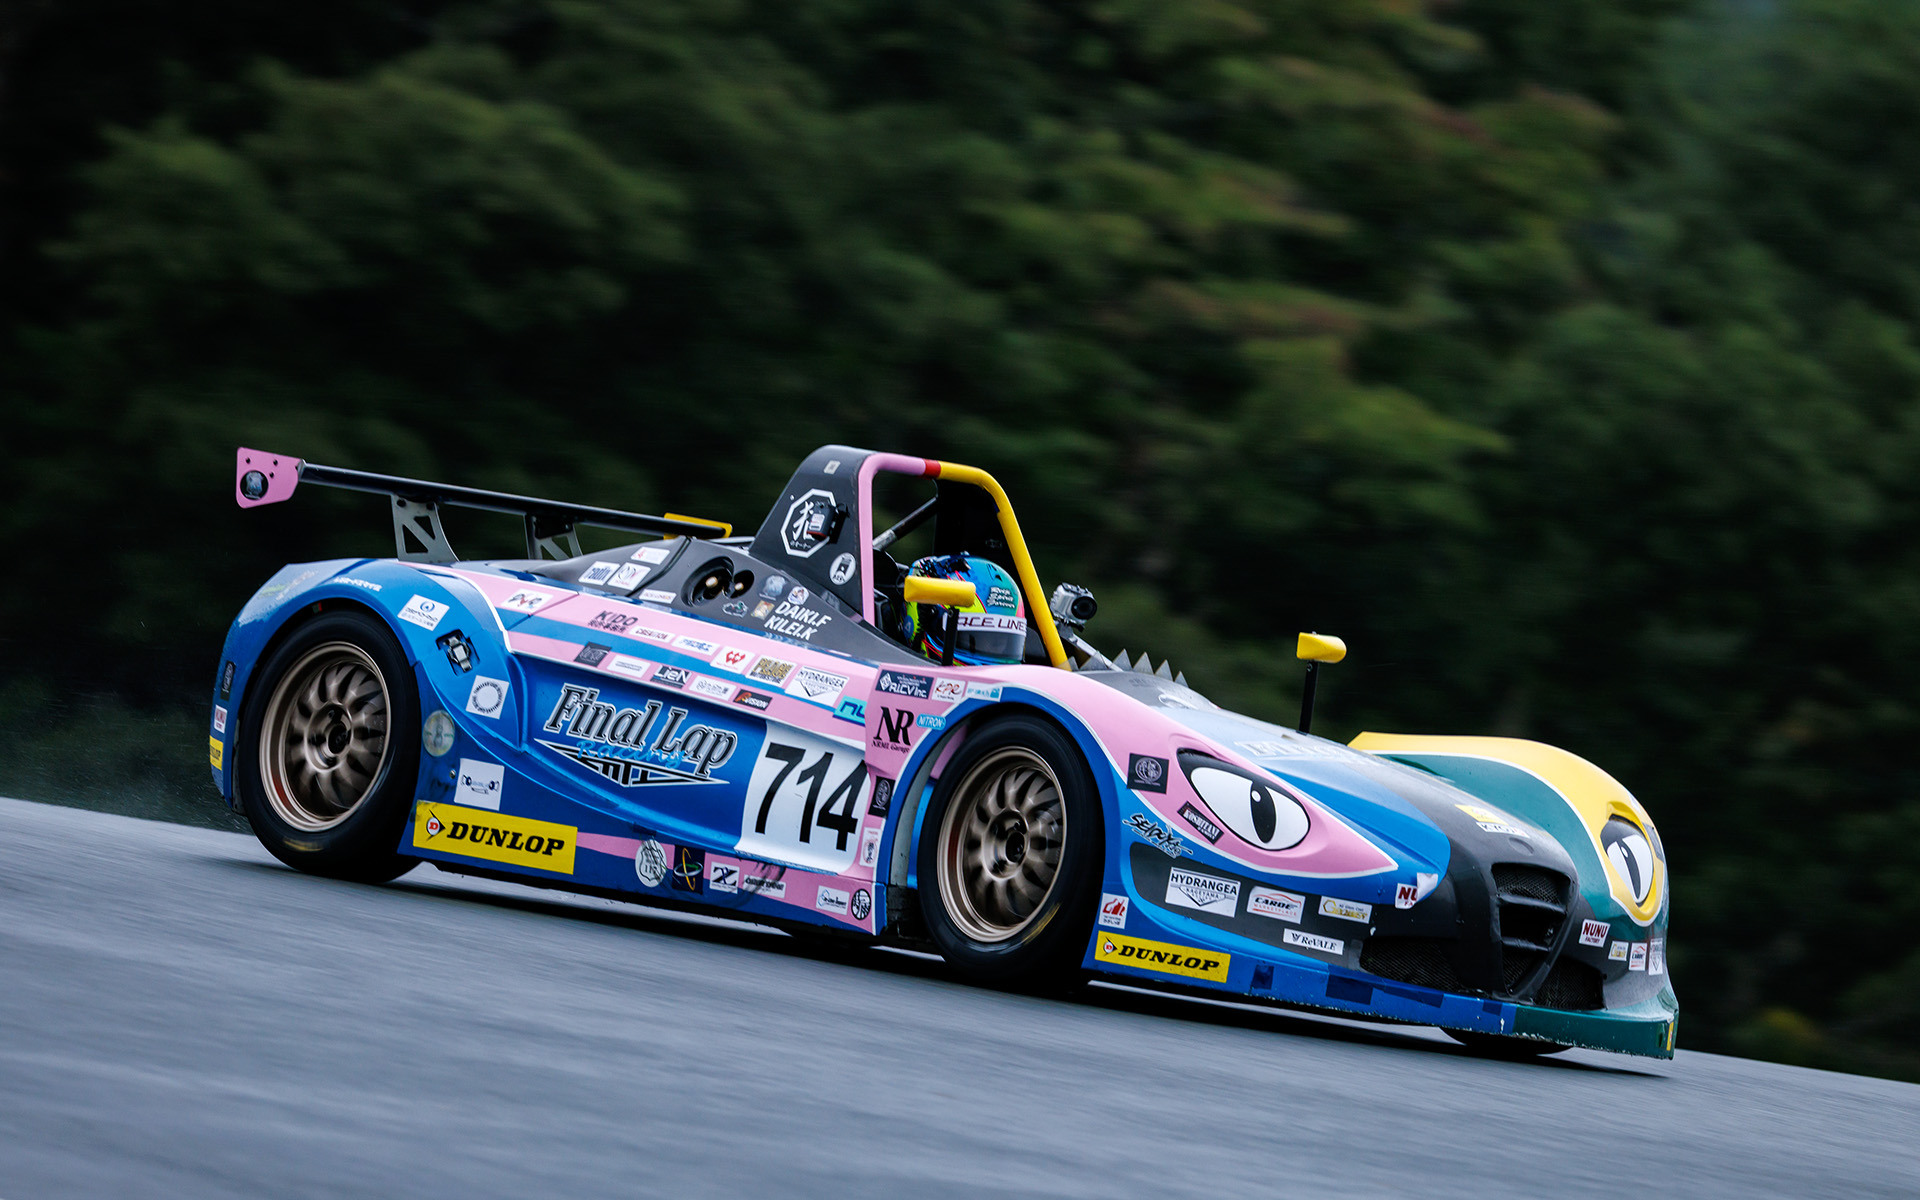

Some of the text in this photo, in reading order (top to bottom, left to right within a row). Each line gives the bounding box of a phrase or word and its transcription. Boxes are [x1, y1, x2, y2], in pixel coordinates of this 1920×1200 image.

[799, 669, 844, 689] HYDRANGEA
[543, 683, 663, 750] Final
[652, 706, 738, 777] Lap
[873, 706, 914, 746] NR
[755, 743, 868, 852] 714
[446, 821, 565, 856] DUNLOP
[1170, 872, 1238, 896] HYDRANGEA
[1582, 922, 1608, 938] NUNU
[1118, 944, 1220, 971] DUNLOP
